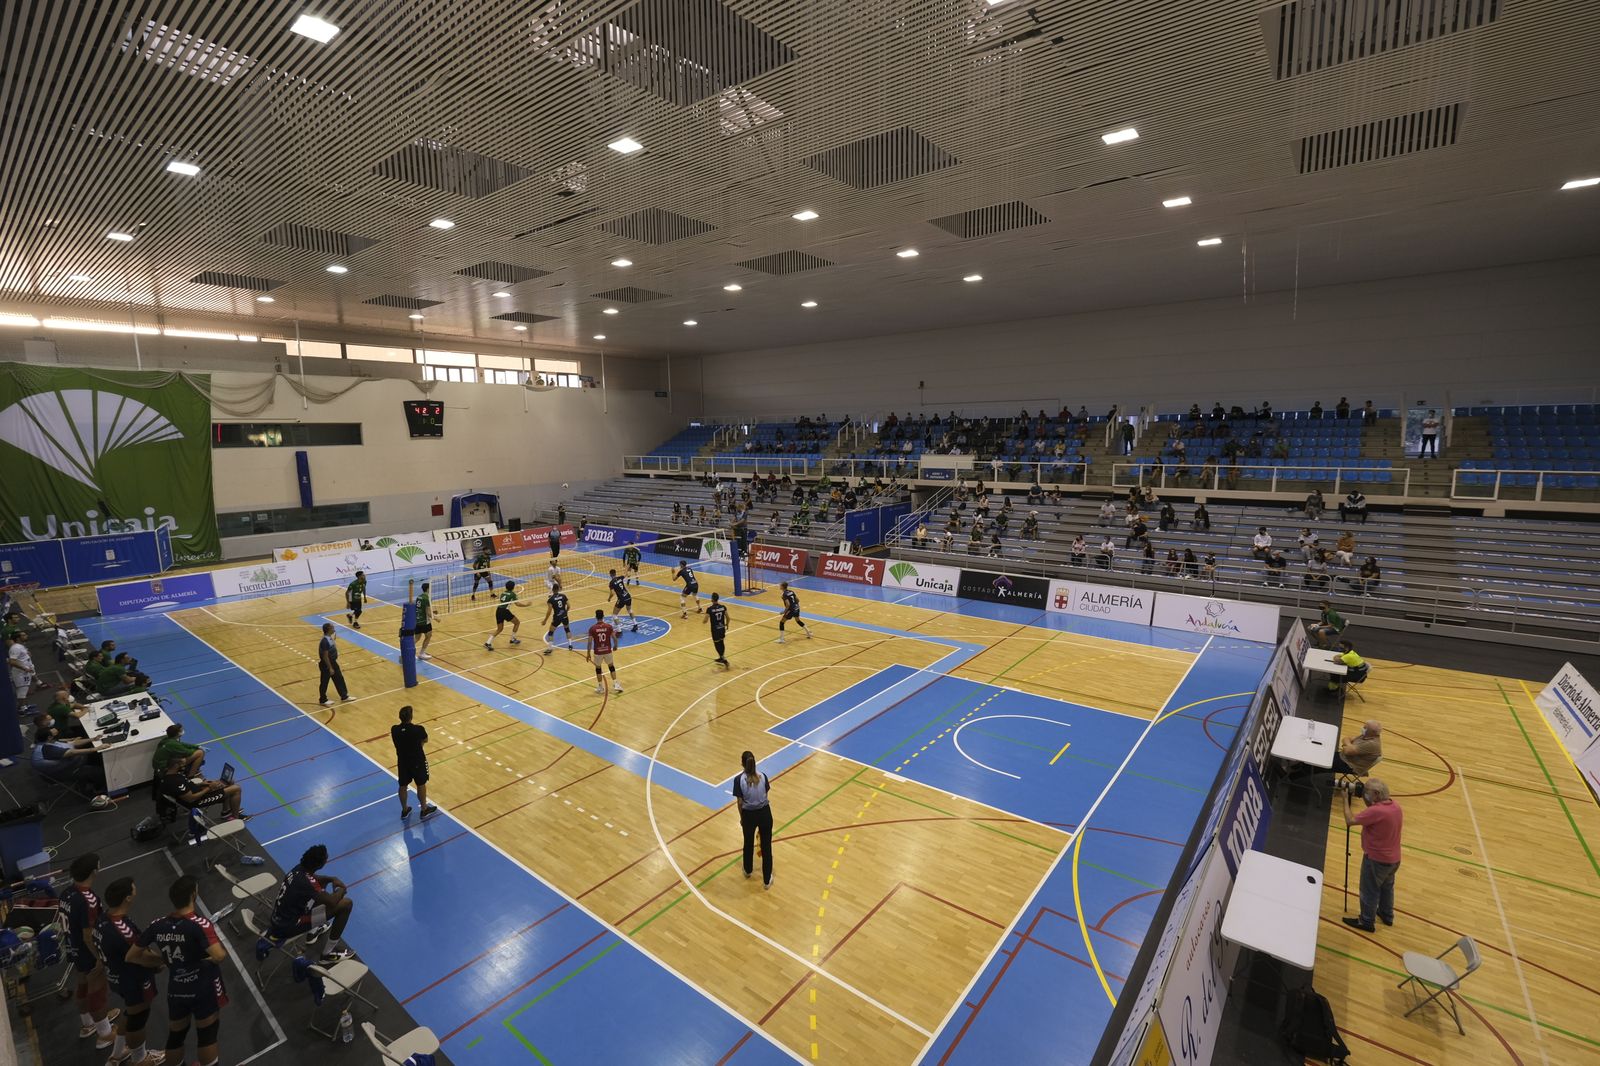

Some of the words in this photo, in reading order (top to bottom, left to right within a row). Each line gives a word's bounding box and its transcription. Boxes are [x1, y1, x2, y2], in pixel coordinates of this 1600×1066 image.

[20, 507, 178, 540] Unicaja
[444, 527, 490, 540] IDEAL
[425, 550, 460, 561] Unicaja
[756, 550, 781, 562] SVM
[825, 559, 854, 573] SVM
[916, 578, 953, 592] Unicaja
[120, 595, 159, 606] DIPUTACIÓN
[171, 590, 198, 599] ALMERÍA
[1007, 589, 1042, 600] ALMERÍA
[1080, 591, 1143, 609] ALMERÍA
[1080, 603, 1111, 614] CIUDAD
[1185, 614, 1240, 633] Andalucía
[598, 633, 606, 642] 10
[1557, 673, 1577, 700] Diario
[1185, 900, 1211, 971] autocares
